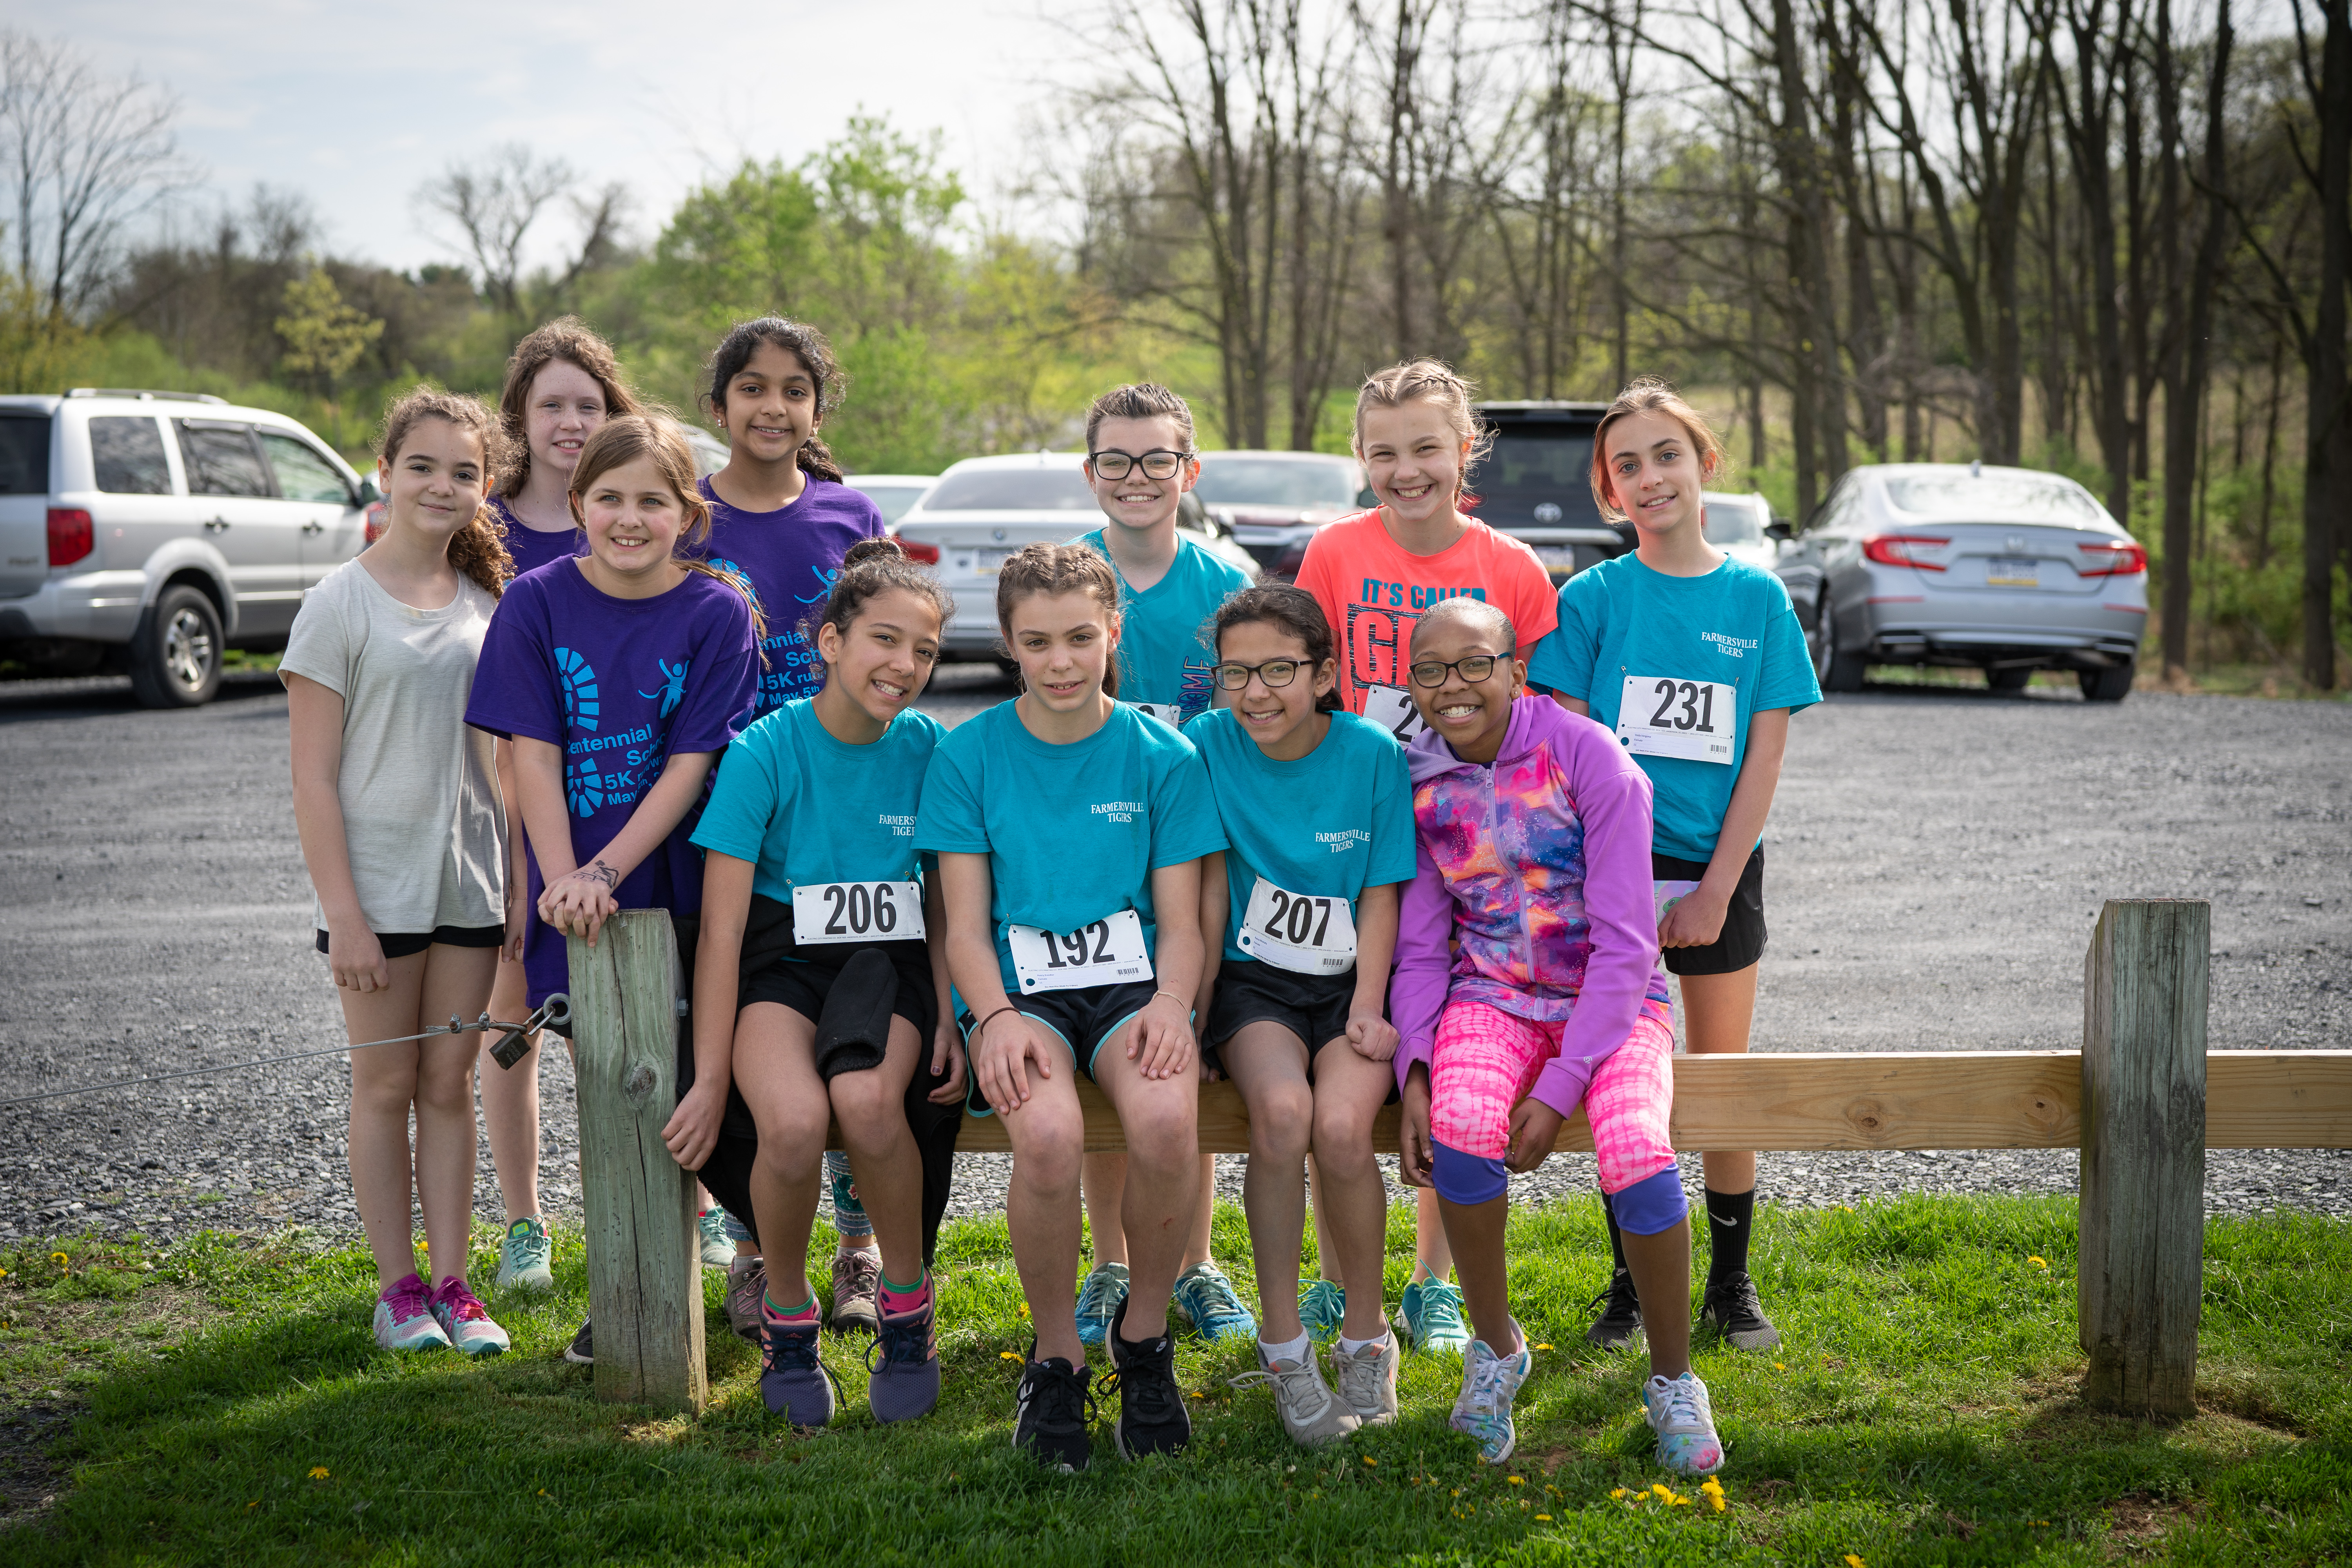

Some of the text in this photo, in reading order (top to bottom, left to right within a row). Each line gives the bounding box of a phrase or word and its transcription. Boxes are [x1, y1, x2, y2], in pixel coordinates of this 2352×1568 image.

[1361, 578, 1403, 606] IT'S
[1702, 632, 1758, 649] FARMERSVILLE
[1717, 643, 1743, 658] TIGERS
[767, 671, 795, 690] 5K
[803, 685, 820, 698] 5th
[1650, 679, 1714, 733] 231
[604, 770, 635, 789] 5K
[608, 790, 637, 805] May
[1091, 801, 1144, 814] FARMERSVILLE
[1108, 813, 1132, 823] TIGERS
[1315, 829, 1370, 842] FARMERSVILLE
[1330, 839, 1354, 853] TIGERS
[823, 883, 897, 935] 206
[1265, 890, 1331, 946] 207
[1040, 919, 1115, 968] 192
